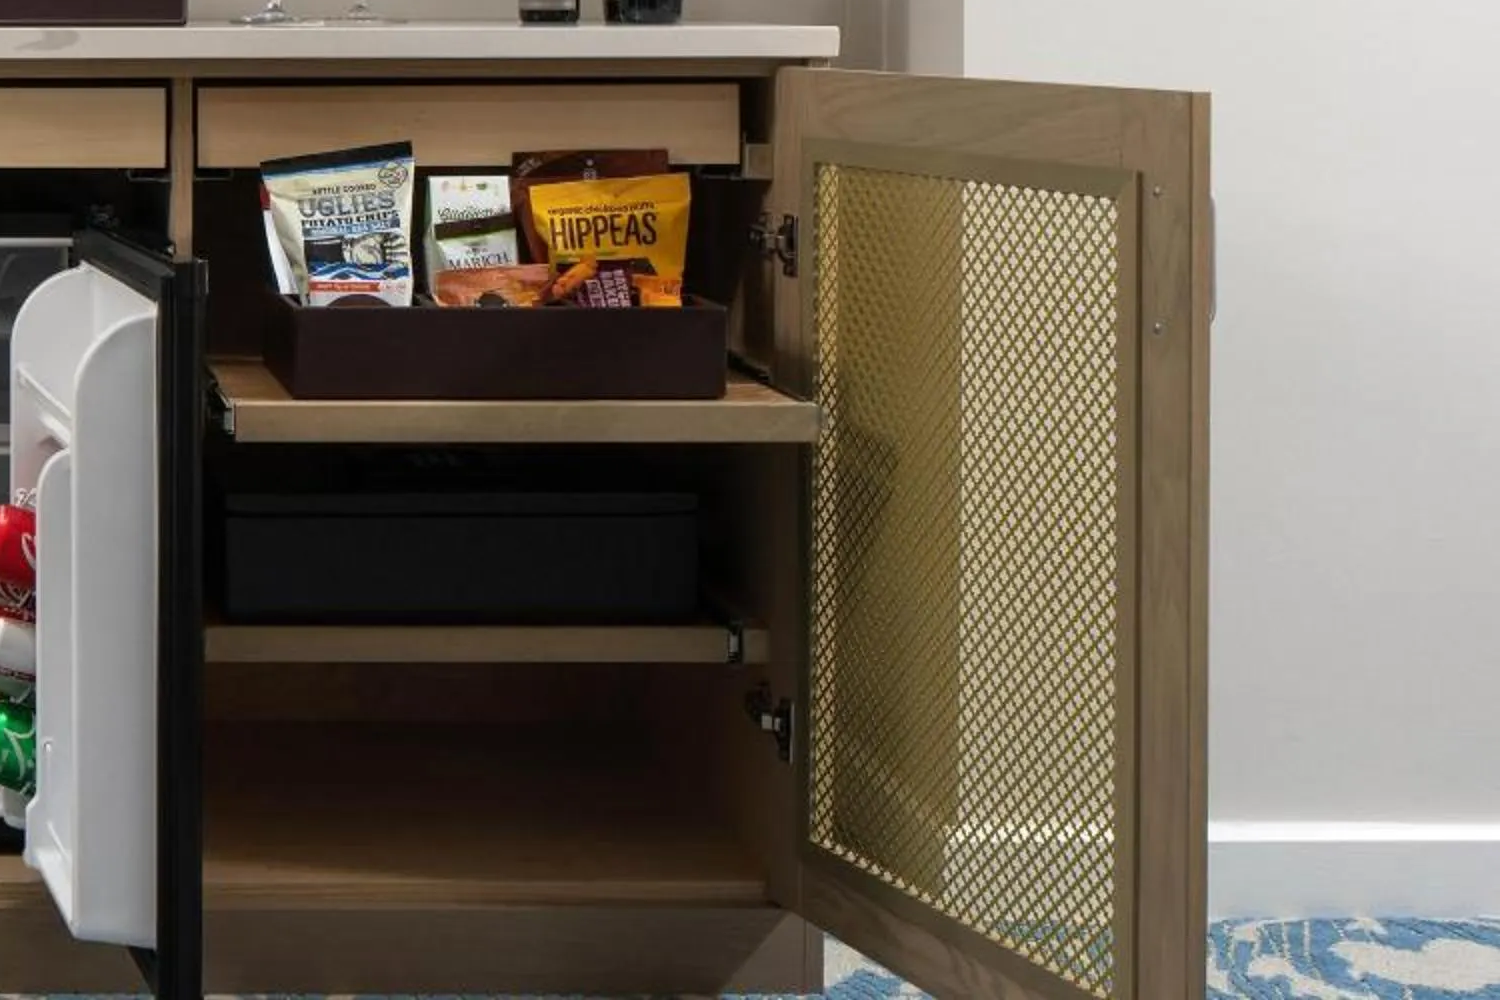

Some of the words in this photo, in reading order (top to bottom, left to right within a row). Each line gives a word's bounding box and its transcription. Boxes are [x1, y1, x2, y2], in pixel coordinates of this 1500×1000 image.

[299, 190, 396, 217] UGLIES
[302, 216, 354, 227] POTATO
[356, 210, 400, 222] CHIPS
[549, 212, 658, 251] HIPPEAS
